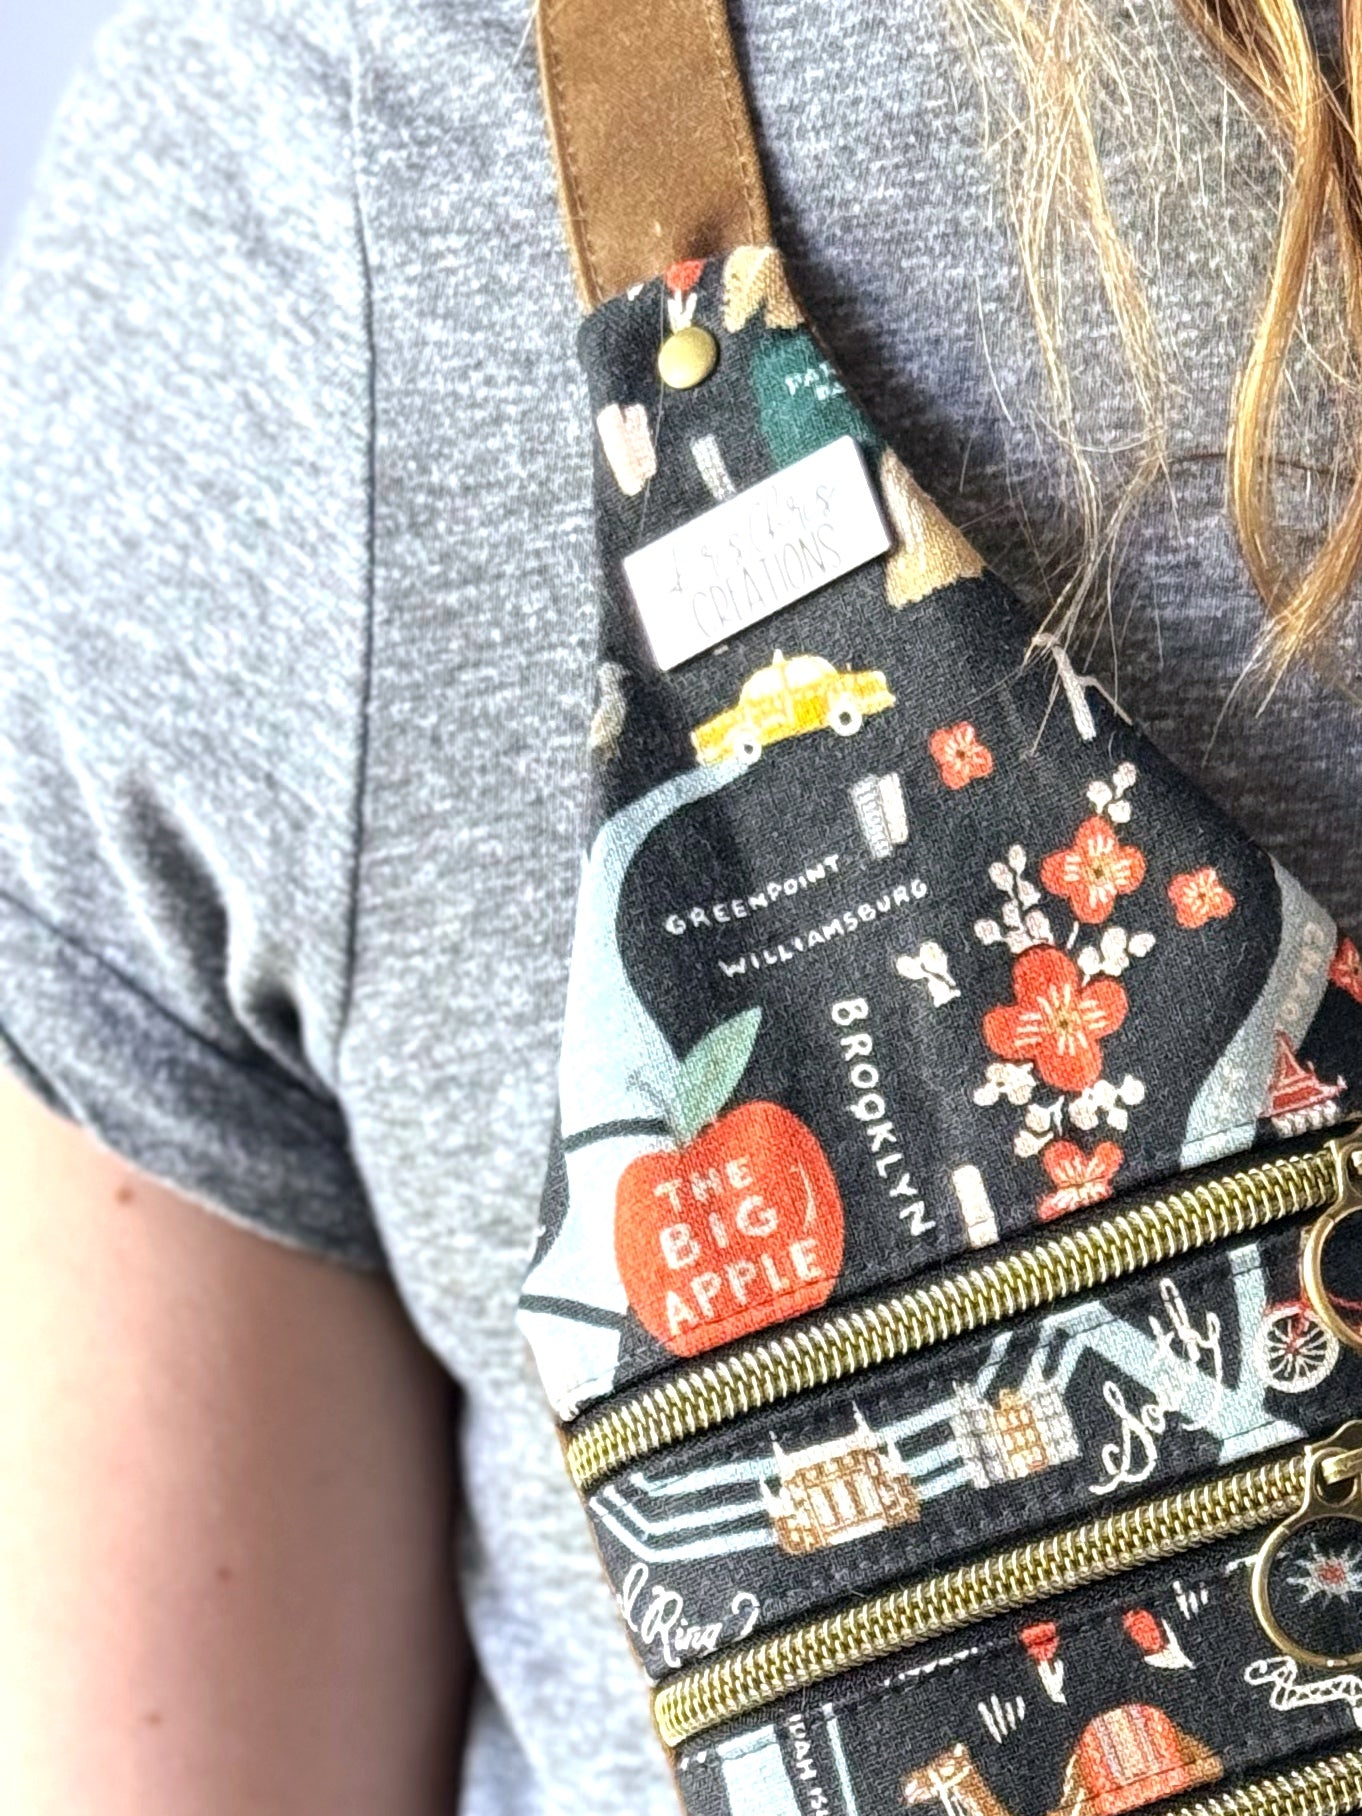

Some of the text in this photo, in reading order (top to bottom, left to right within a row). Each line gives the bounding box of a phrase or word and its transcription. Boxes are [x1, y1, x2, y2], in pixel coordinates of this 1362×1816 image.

[665, 854, 839, 935] GREENPOINT
[718, 878, 927, 978] WILLIAMSBURG
[831, 998, 936, 1236] BROOKLYN
[654, 1157, 753, 1213] THE
[659, 1195, 779, 1271] BIG
[665, 1239, 824, 1336] APPLE
